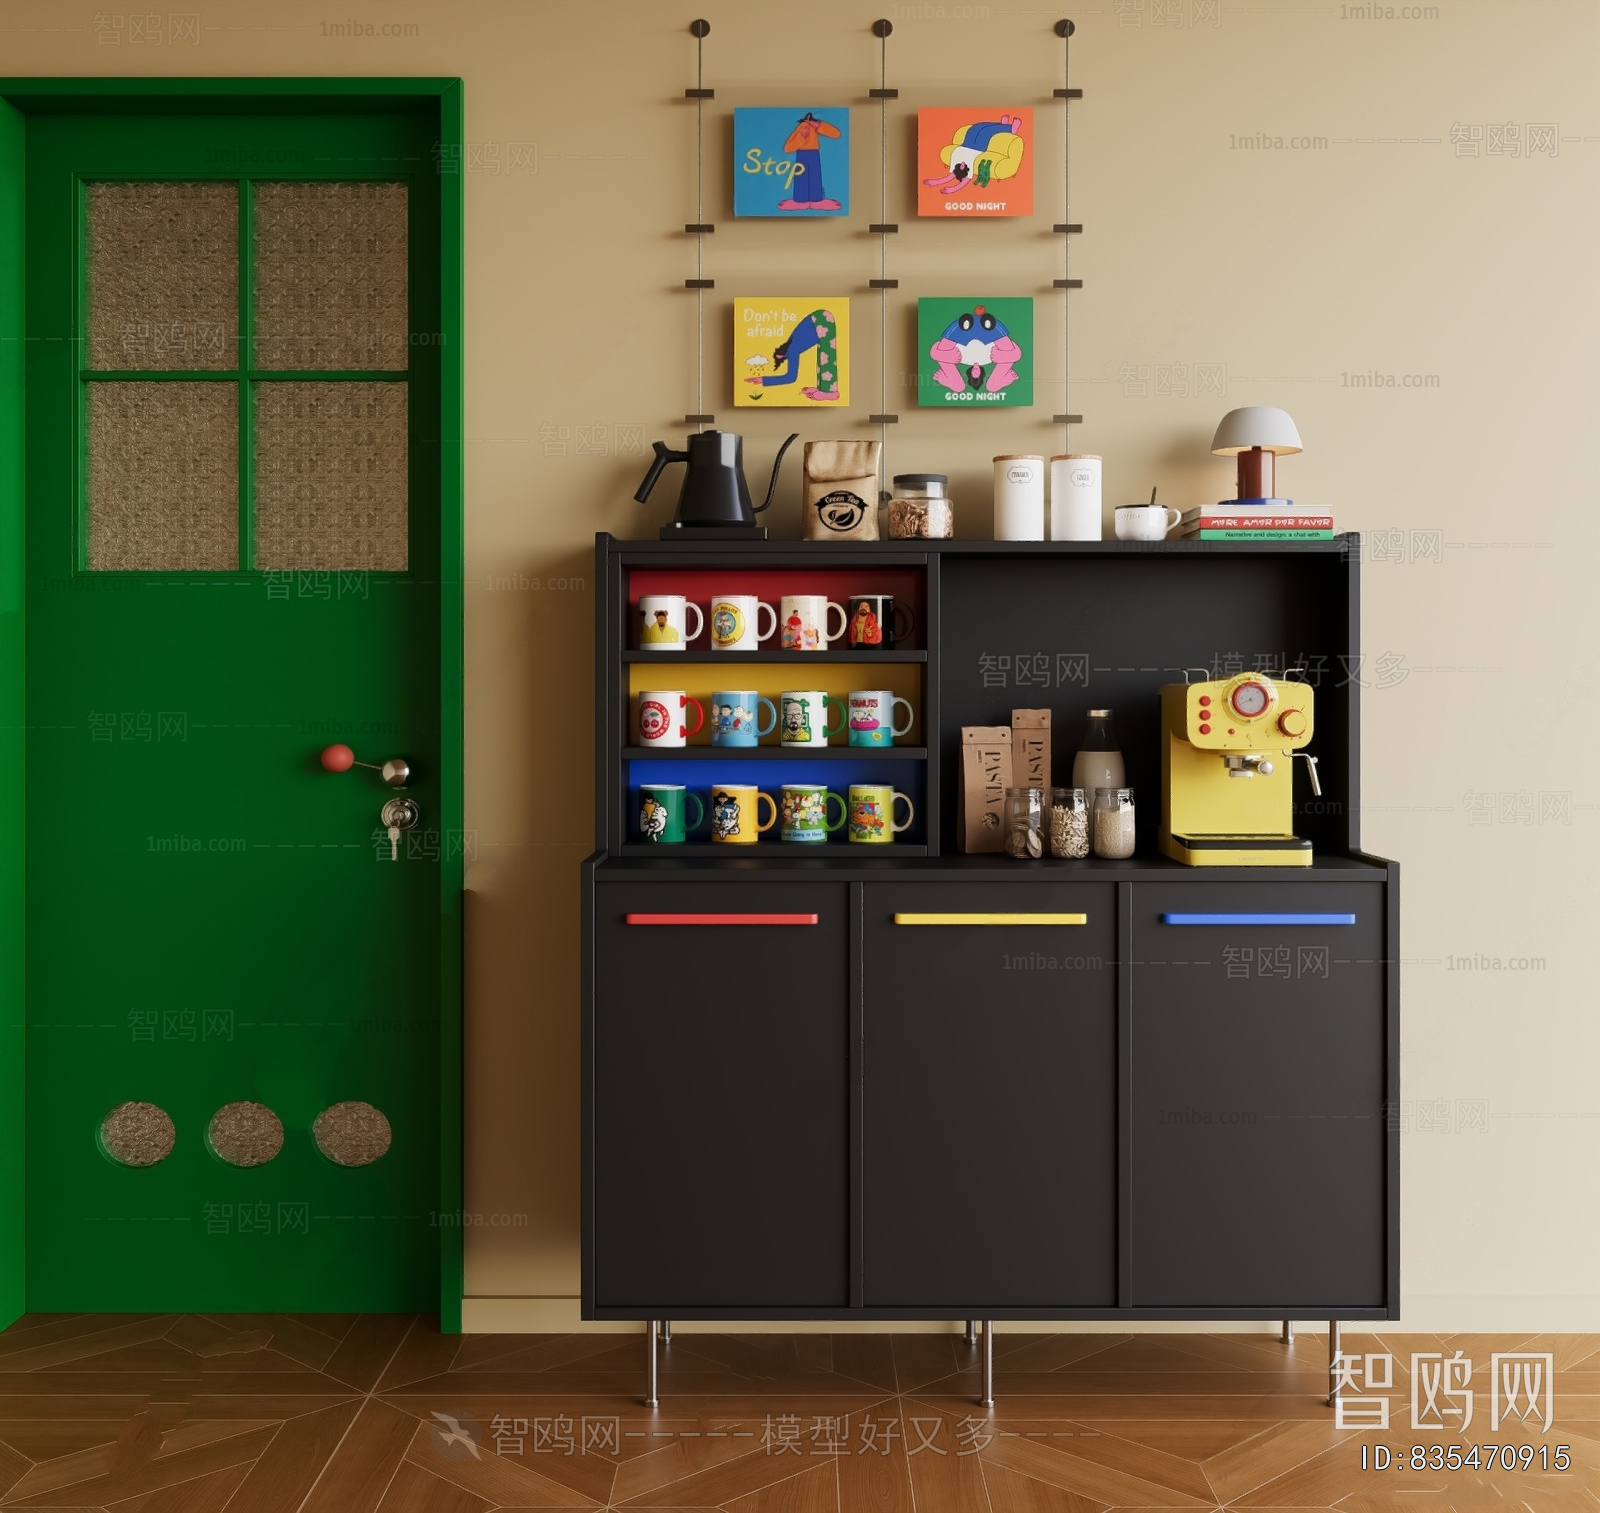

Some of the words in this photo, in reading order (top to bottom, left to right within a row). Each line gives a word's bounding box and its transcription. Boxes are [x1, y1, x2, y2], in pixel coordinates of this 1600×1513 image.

[742, 147, 806, 190] Stop
[945, 202, 974, 211] GOOD
[976, 202, 1007, 211] NIGHT
[743, 307, 779, 323] Don't
[782, 308, 797, 322] be
[747, 323, 784, 338] afraid
[945, 392, 974, 401] GOOD
[976, 392, 1007, 401] NIGHT
[1211, 518, 1239, 526] MORE
[1243, 518, 1273, 526] AMOR
[1298, 518, 1331, 526] FAVOR
[1028, 740, 1044, 787] PAST
[984, 751, 1004, 805] PASTA
